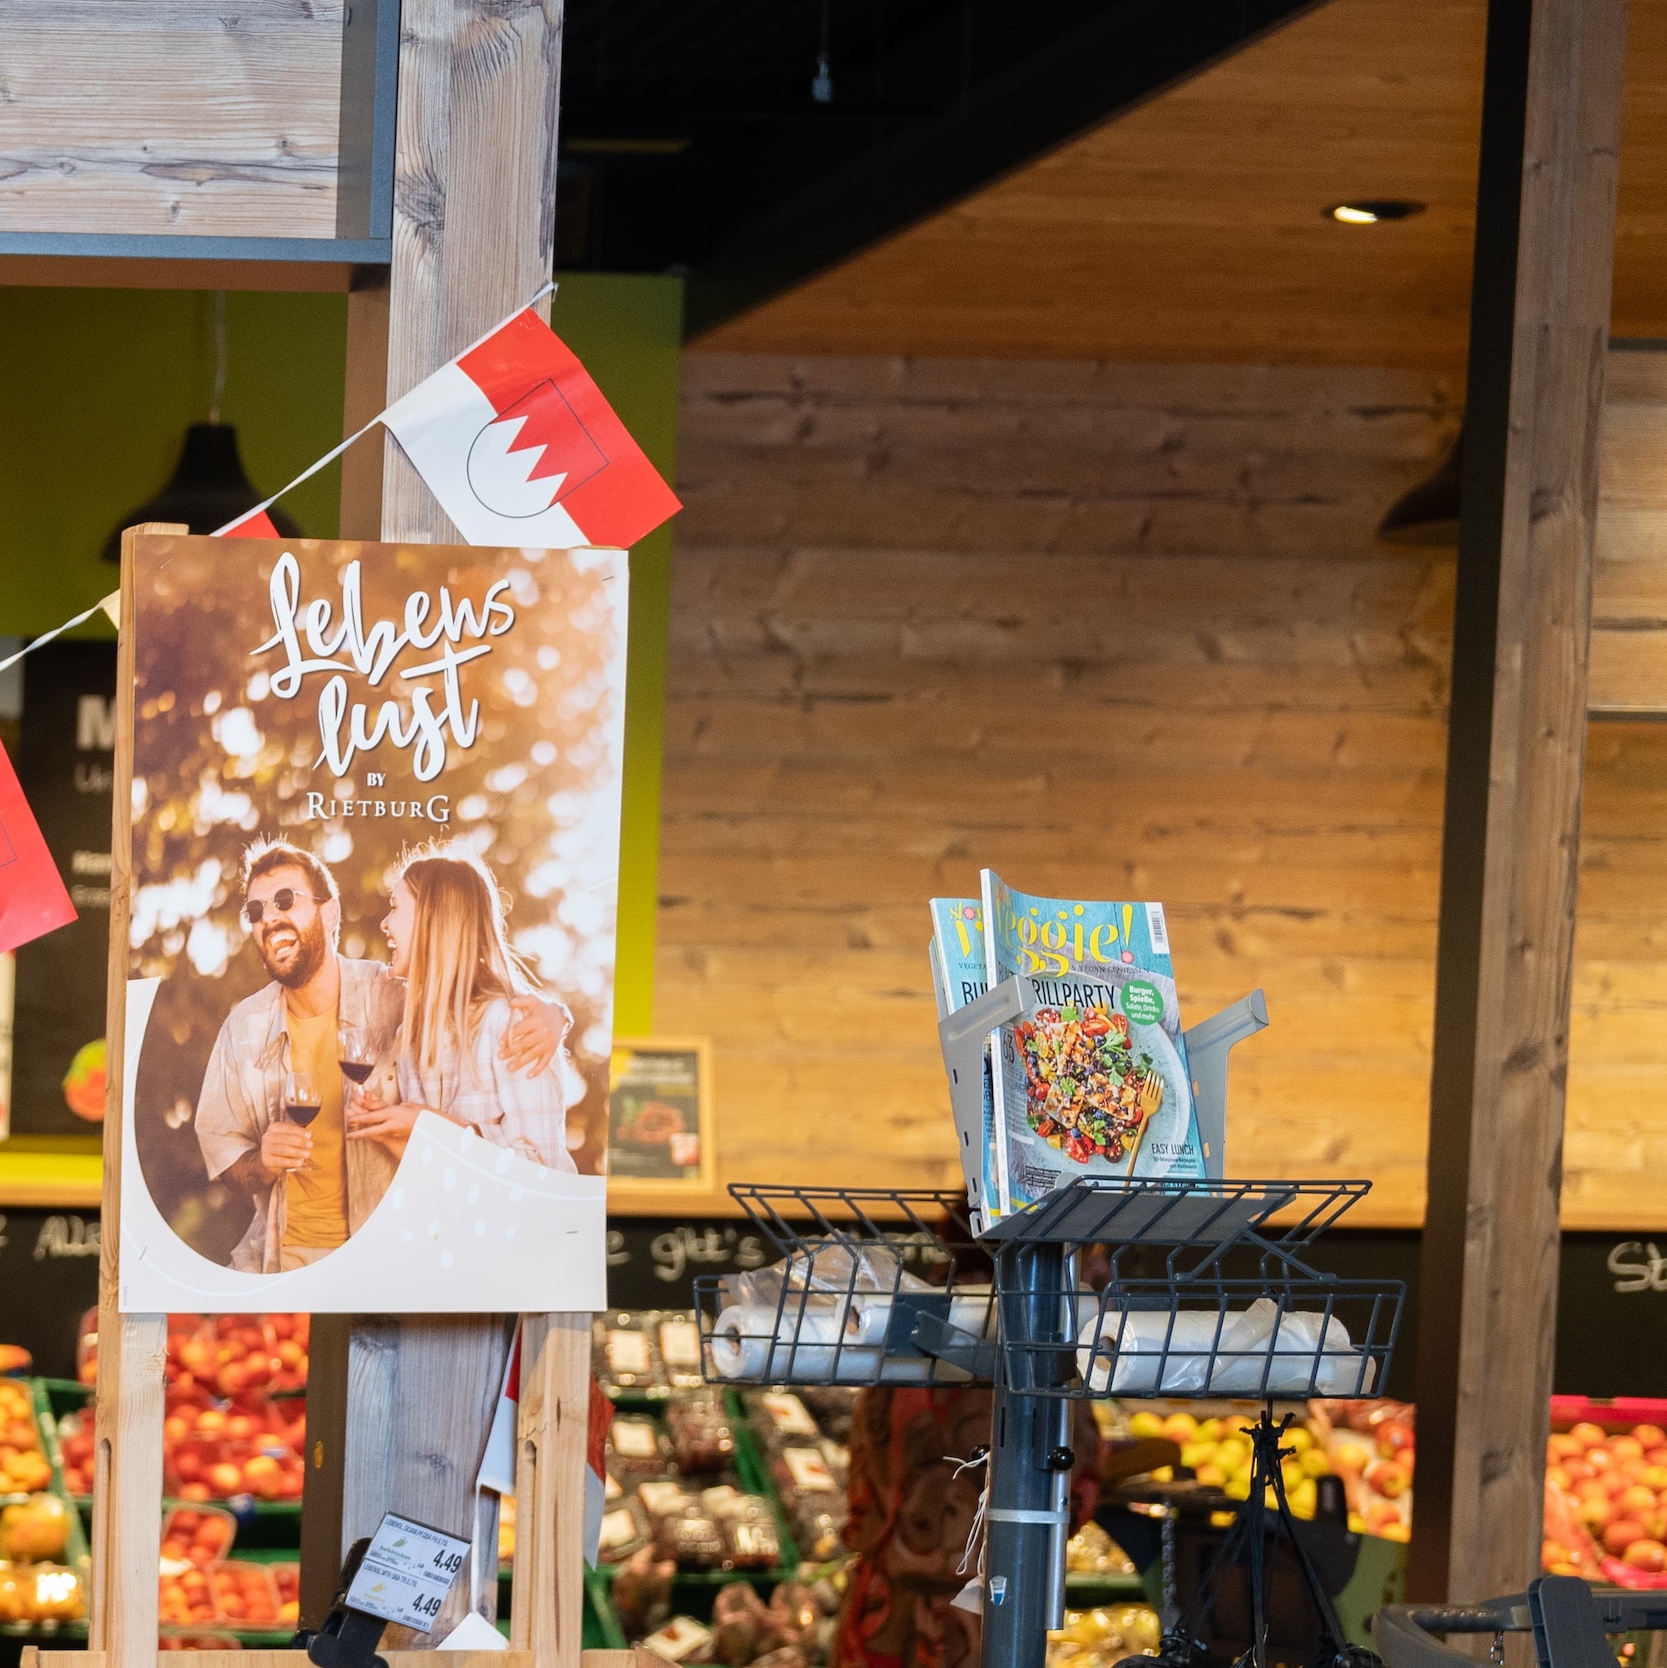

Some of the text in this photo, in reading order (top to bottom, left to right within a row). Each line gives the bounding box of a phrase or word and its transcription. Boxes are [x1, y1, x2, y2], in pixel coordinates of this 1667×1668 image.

[250, 551, 517, 698] Lebens
[313, 641, 492, 782] lust
[367, 773, 386, 787] BY
[306, 792, 451, 823] RIETBURG
[1026, 977, 1115, 1009] RILLPARTY
[1129, 986, 1154, 995] Burger,
[1151, 1143, 1194, 1155] EASY LUNCH
[434, 1549, 462, 1573] 4.49
[412, 1593, 441, 1617] 4.49
